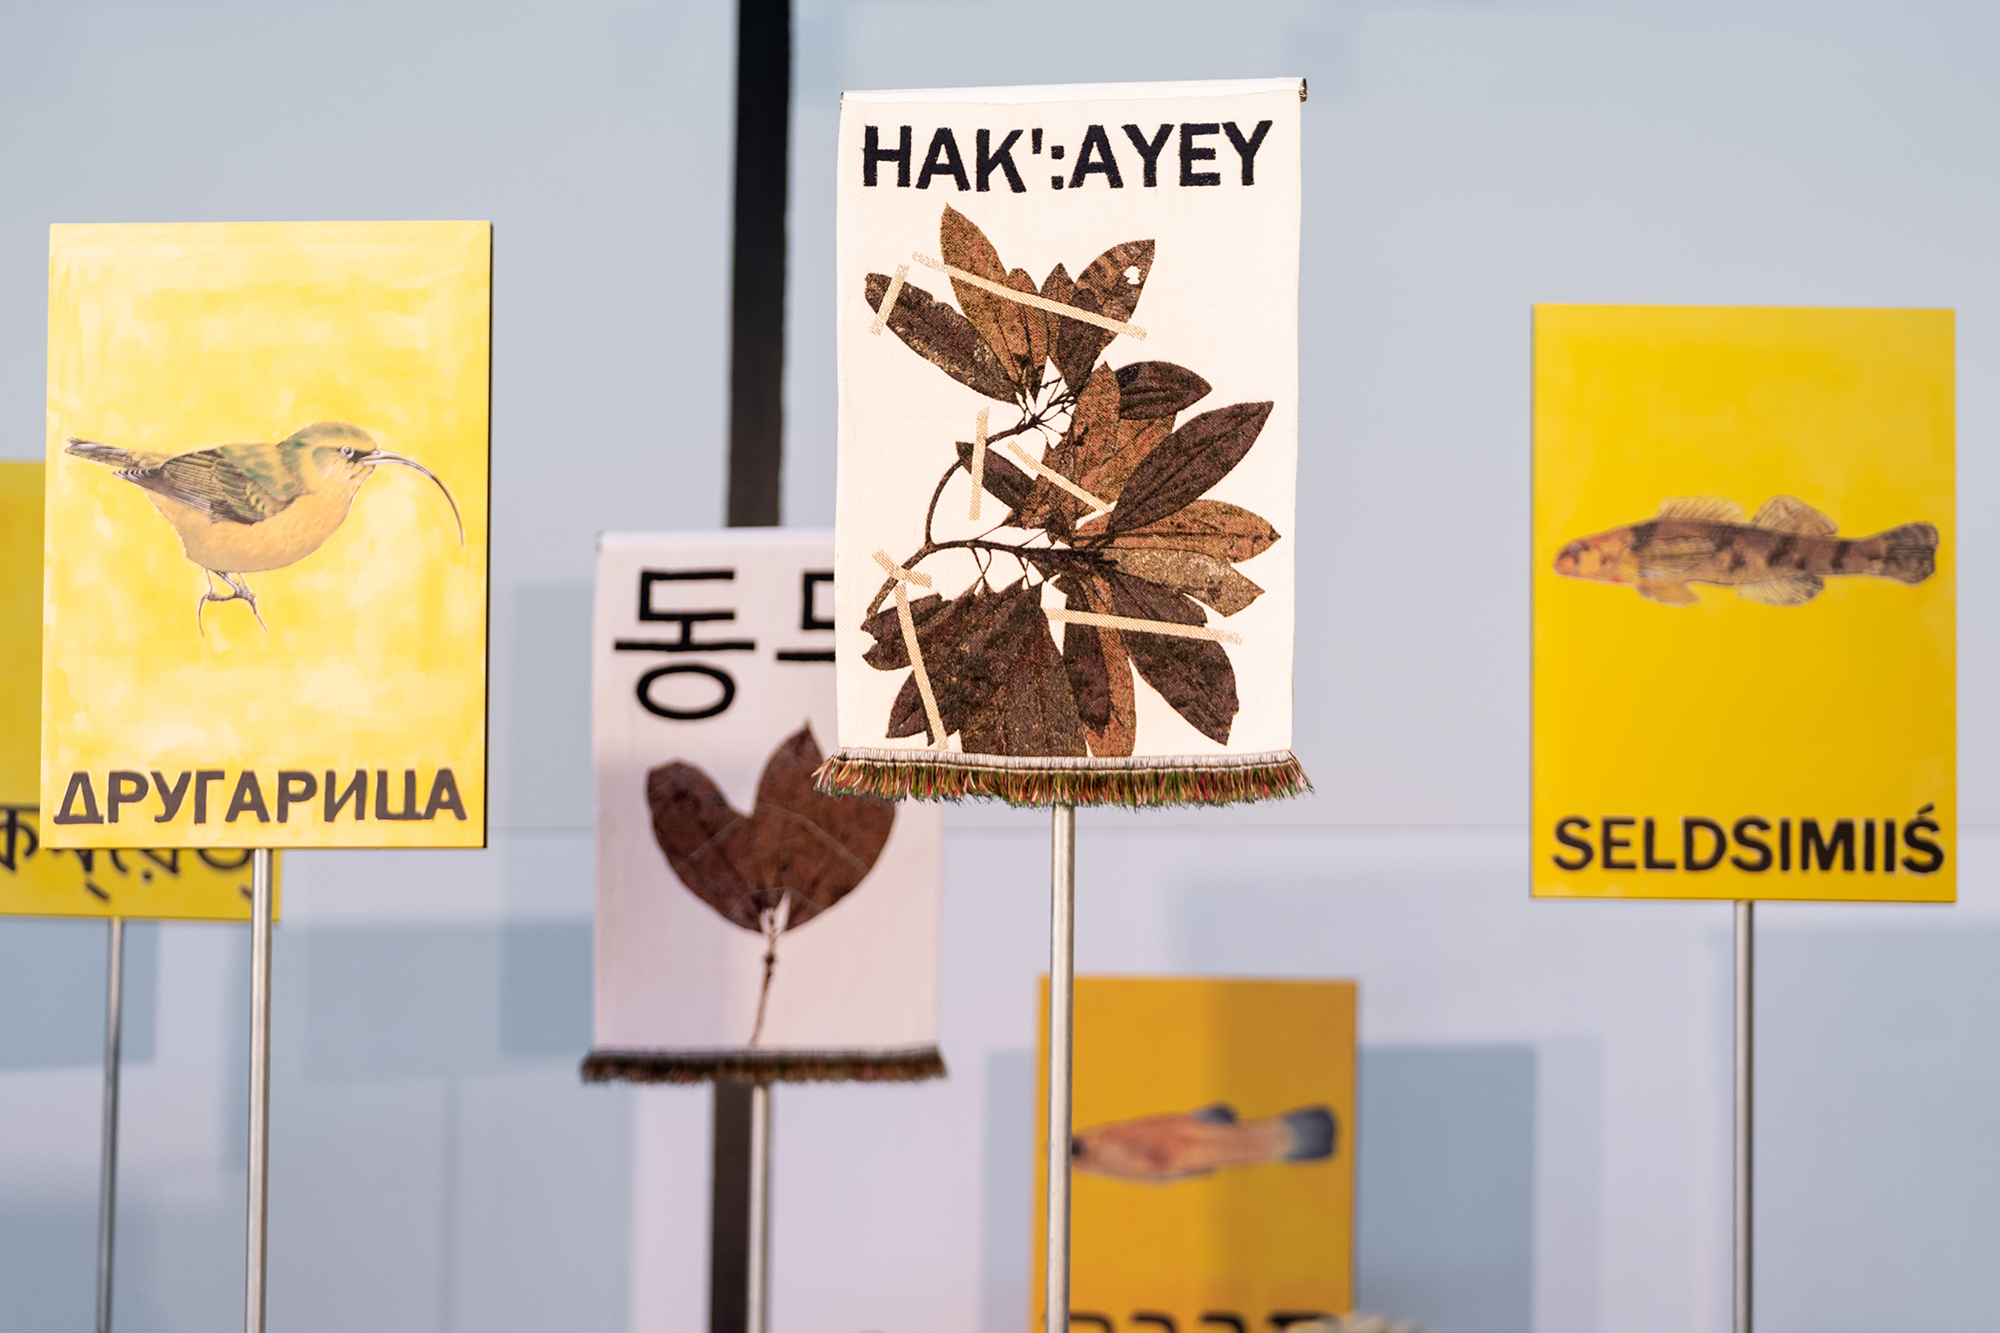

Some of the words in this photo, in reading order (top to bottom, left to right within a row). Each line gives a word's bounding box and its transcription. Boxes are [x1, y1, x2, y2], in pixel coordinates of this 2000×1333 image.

[863, 119, 1273, 193] HAK':AYEY
[53, 768, 468, 825] ДРУГАРИЦА
[1552, 802, 1945, 874] SELDSIMIIŚ
